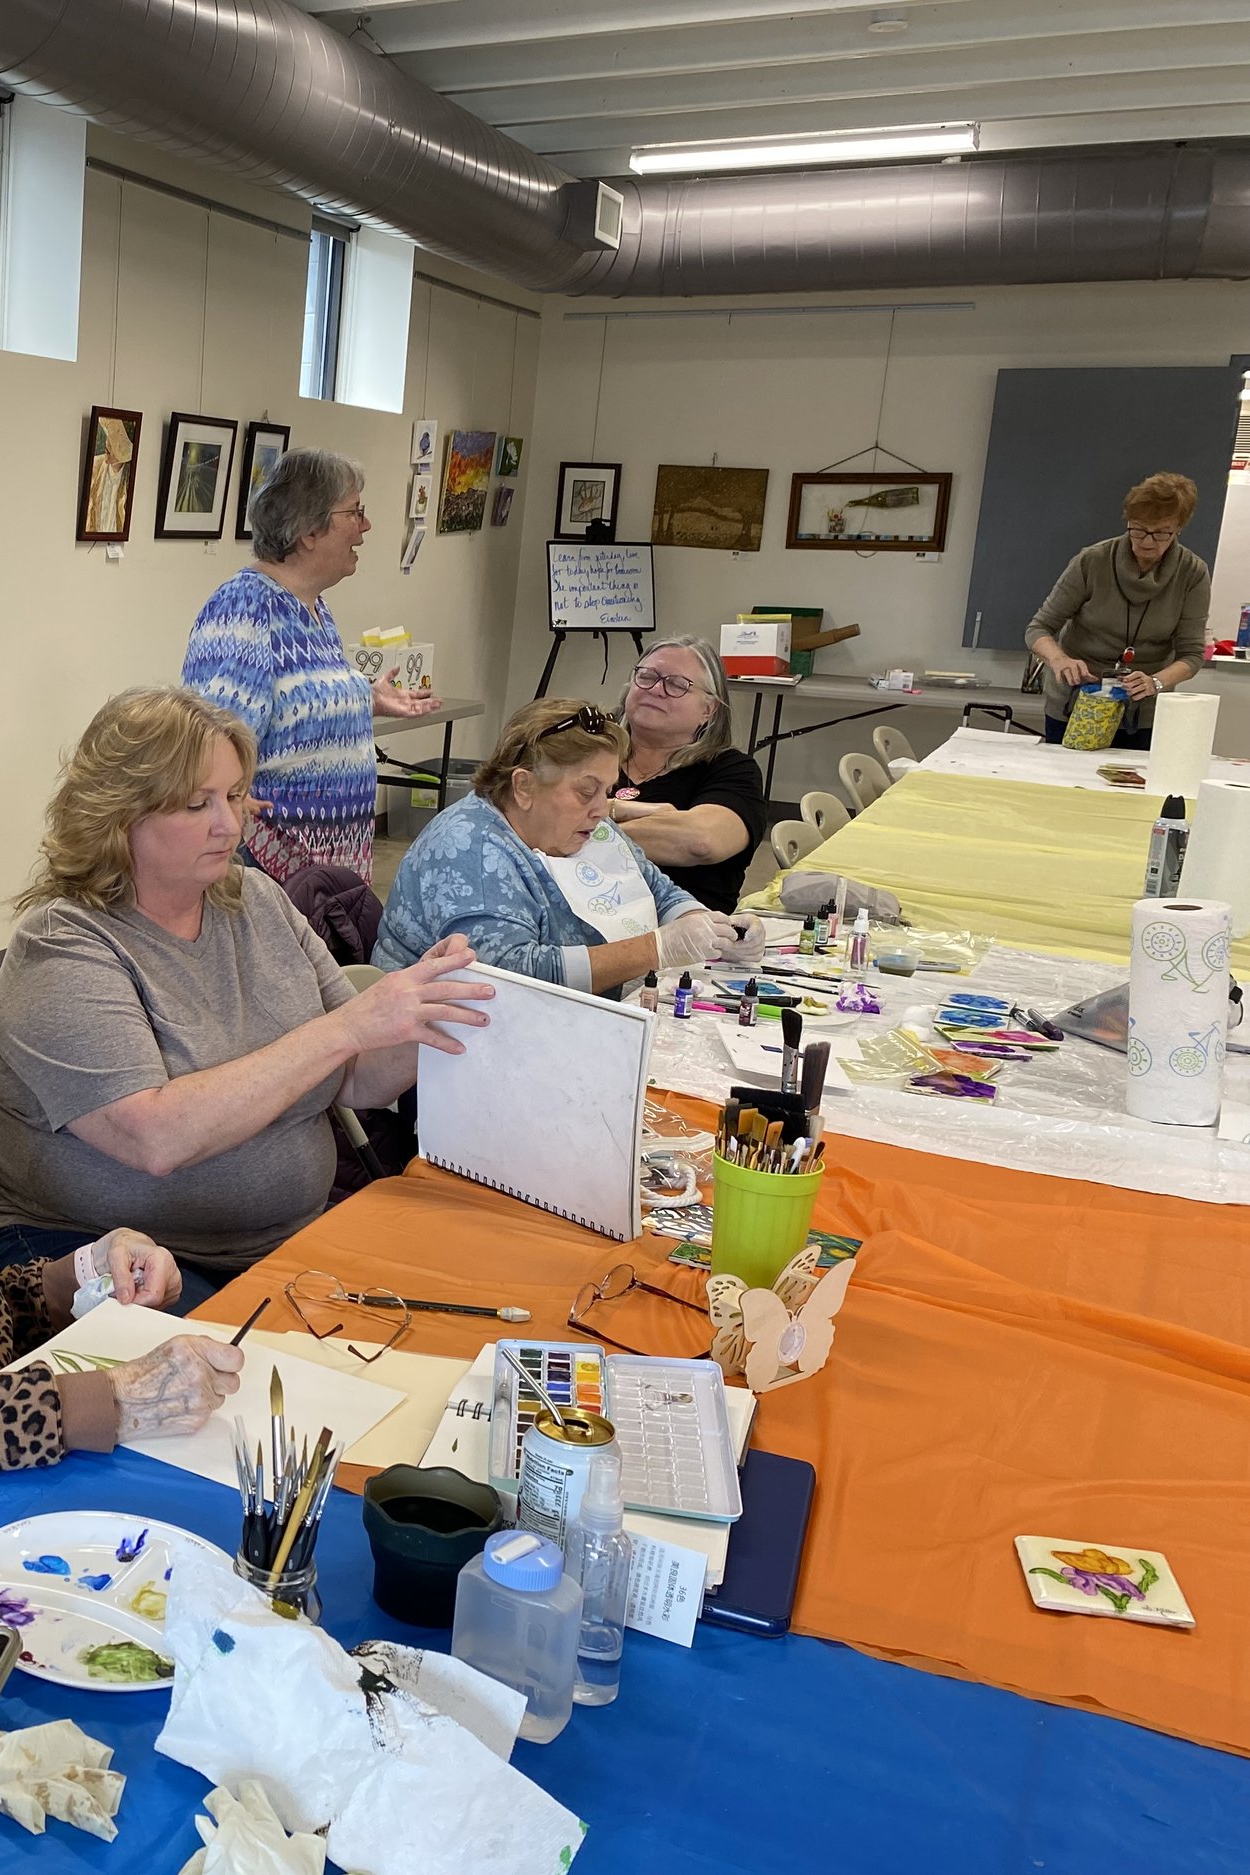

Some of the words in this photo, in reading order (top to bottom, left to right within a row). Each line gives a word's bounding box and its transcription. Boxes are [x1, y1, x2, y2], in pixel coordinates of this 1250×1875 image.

[553, 546, 576, 563] Learn
[607, 579, 633, 597] thing
[554, 597, 569, 611] not
[573, 597, 583, 609] to
[583, 596, 600, 611] stop
[546, 1465, 565, 1476] Facts
[676, 1585, 687, 1604] 36色
